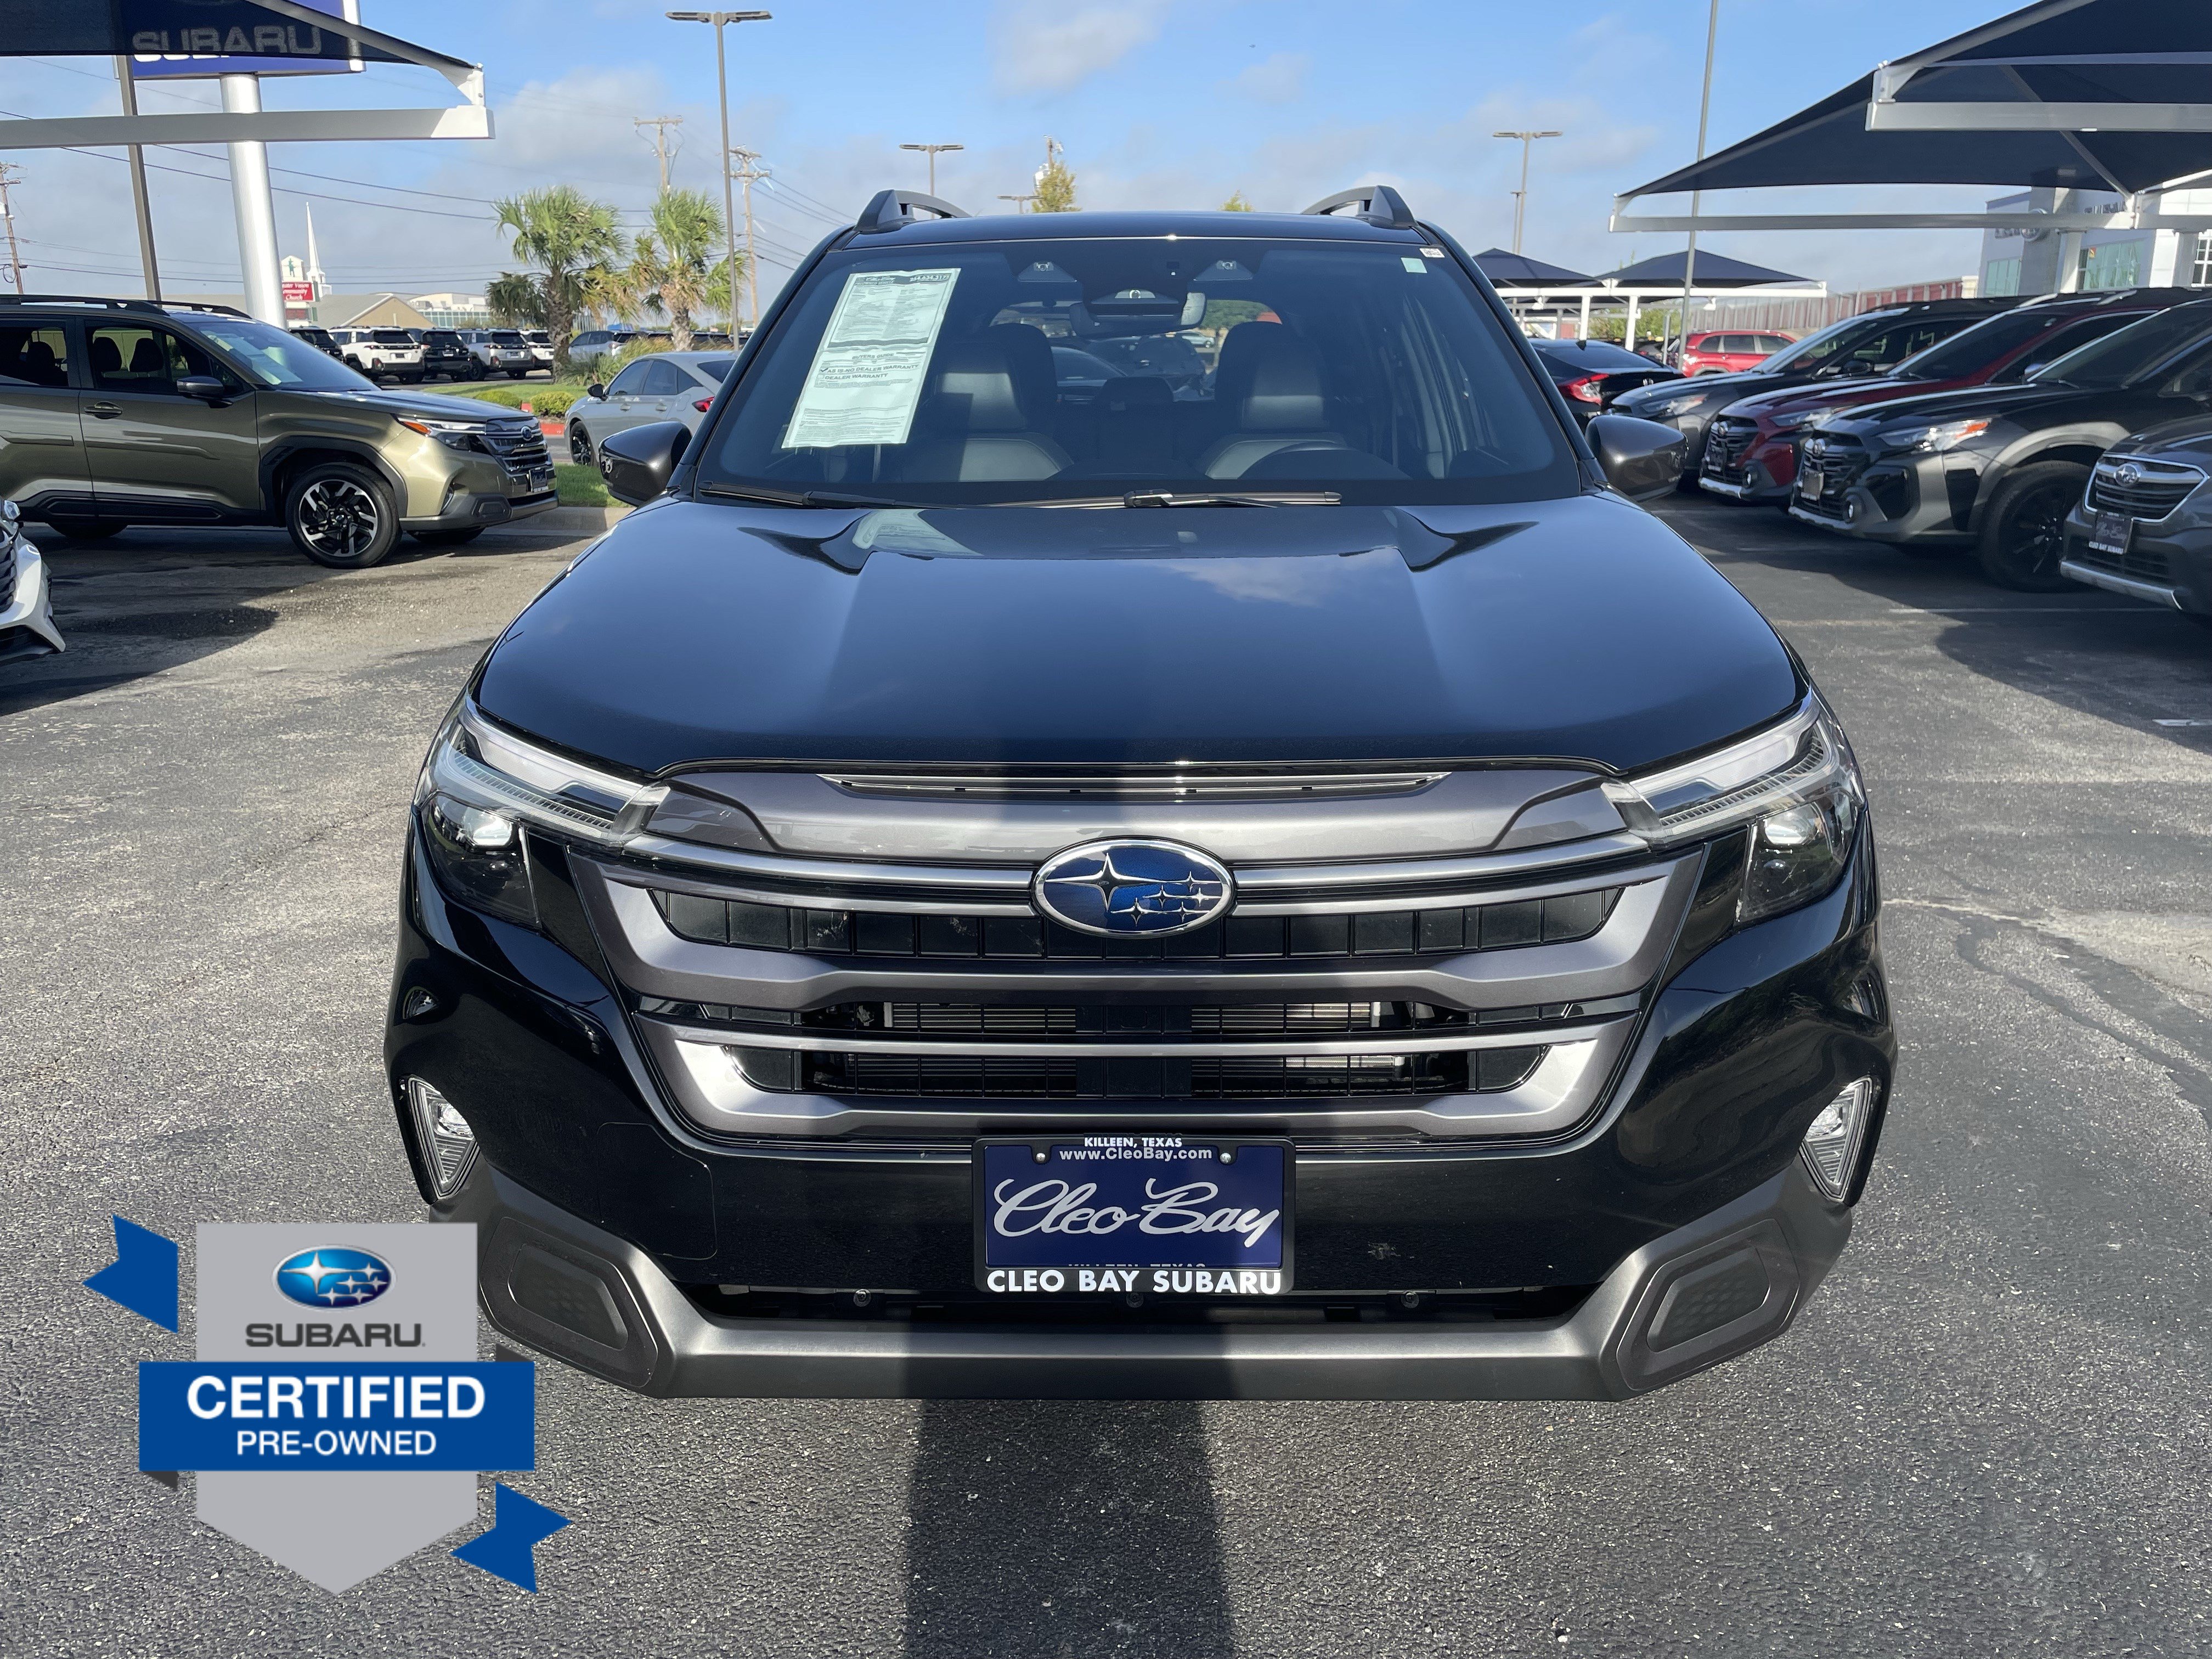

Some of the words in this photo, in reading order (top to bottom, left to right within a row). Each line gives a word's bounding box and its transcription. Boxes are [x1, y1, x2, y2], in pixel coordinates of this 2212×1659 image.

[133, 26, 321, 62] SUBARU
[1059, 1147, 1212, 1162] www.CleoBay.com
[1084, 1137, 1137, 1148] KILLEEN,
[1141, 1137, 1182, 1148] TEXAS
[994, 1178, 1141, 1237] Cleo
[1139, 1178, 1280, 1248] Bay
[987, 1269, 1065, 1293] CLEO
[1079, 1270, 1140, 1292] BAY
[1153, 1269, 1282, 1295] SUBARU
